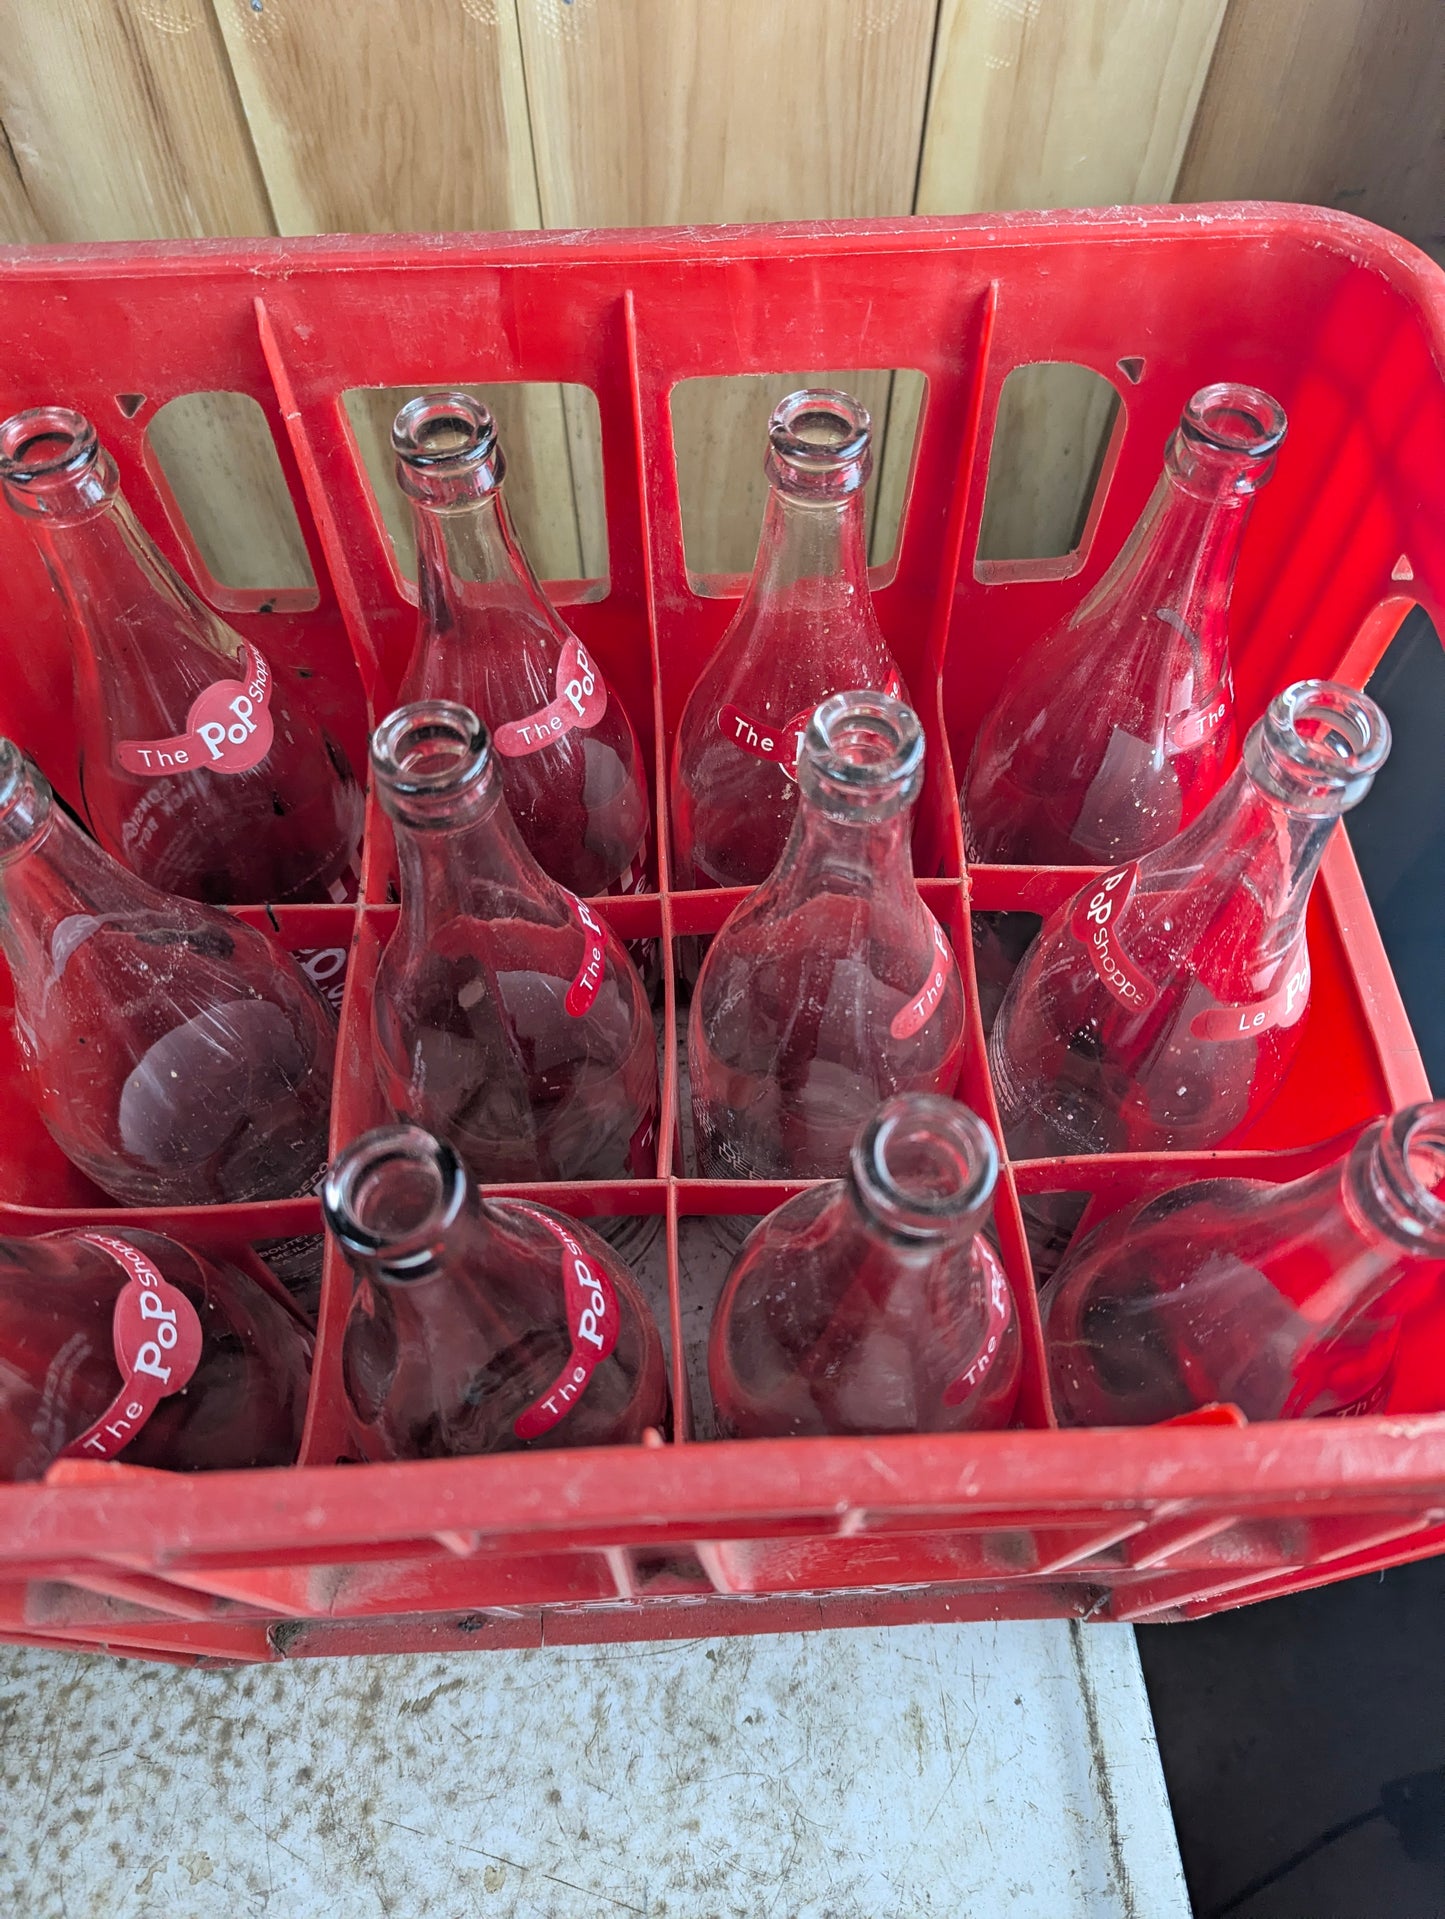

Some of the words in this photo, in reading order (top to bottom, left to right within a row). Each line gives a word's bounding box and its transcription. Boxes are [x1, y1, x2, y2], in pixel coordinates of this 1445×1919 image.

[516, 716, 563, 745] The
[734, 716, 775, 752] The
[1195, 702, 1226, 736] The
[137, 749, 189, 768] The
[580, 947, 601, 991] The
[912, 971, 943, 1017] The
[1239, 1011, 1266, 1031] Le
[541, 1366, 586, 1414] The
[83, 1401, 143, 1453] The
